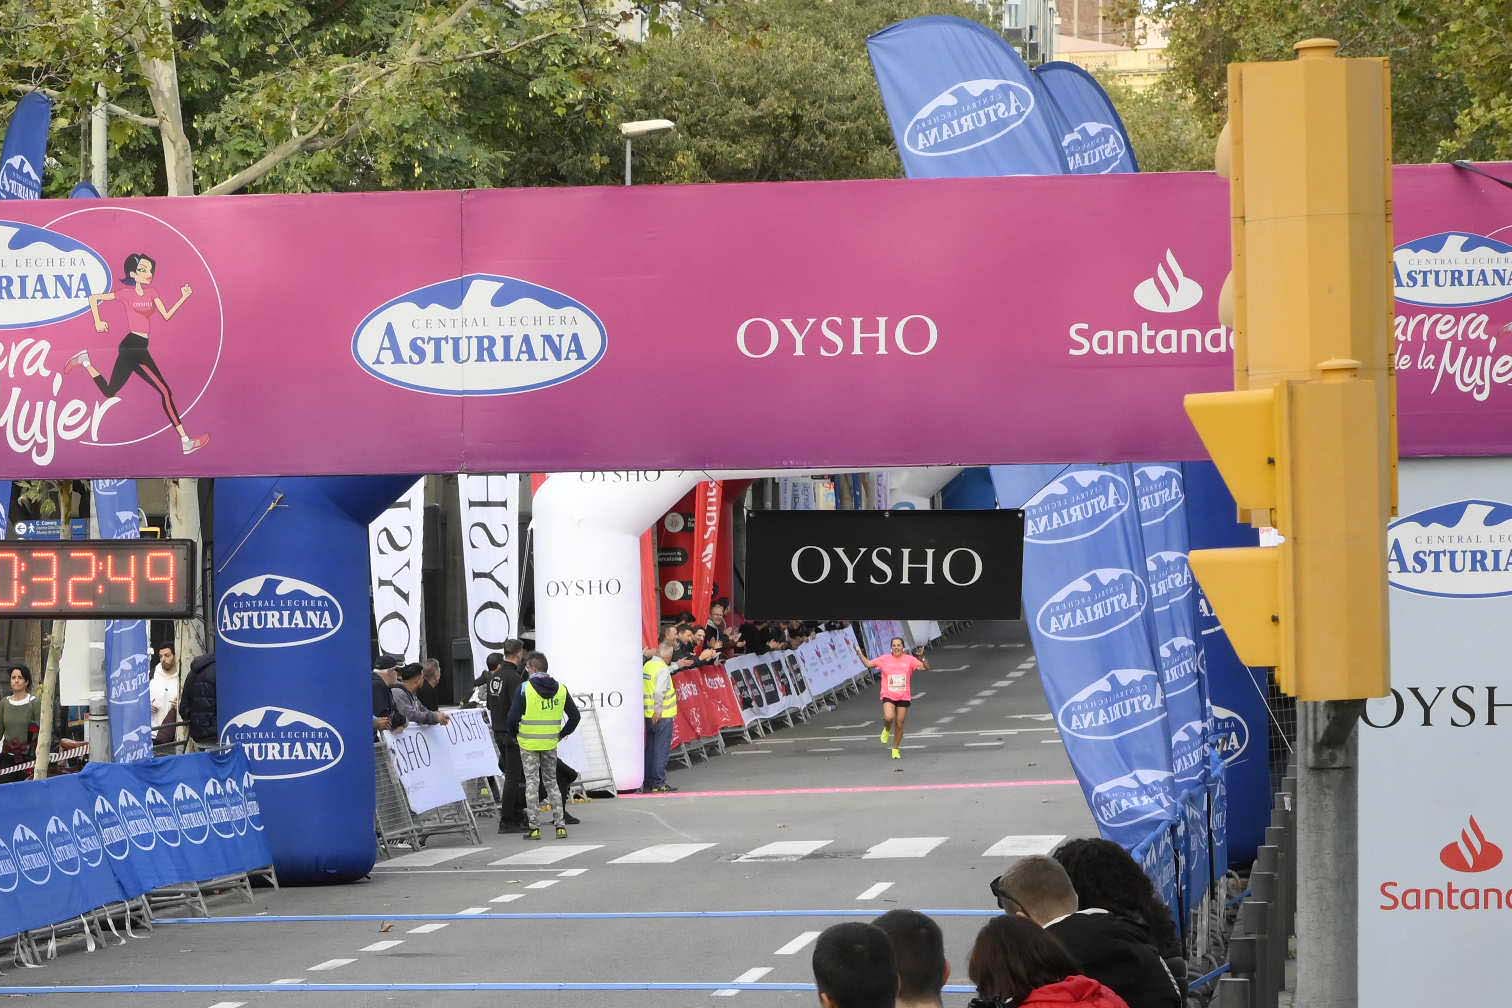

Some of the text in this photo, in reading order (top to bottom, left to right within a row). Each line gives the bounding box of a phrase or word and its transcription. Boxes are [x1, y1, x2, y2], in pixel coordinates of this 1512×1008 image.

[14, 256, 88, 269] LECHERA
[410, 314, 579, 330] CENTRAL LECHERA
[372, 321, 588, 365] ASTURIANA
[736, 314, 938, 359] OYSHO
[1418, 342, 1435, 370] la
[1431, 337, 1512, 402] Muje
[1415, 534, 1482, 545] CENTRAL
[790, 544, 984, 586] OYSHO
[546, 578, 622, 598] OYSHO
[280, 599, 329, 608] LECHERA
[221, 604, 334, 632] ASTURIANA
[280, 731, 329, 739] LECHERA
